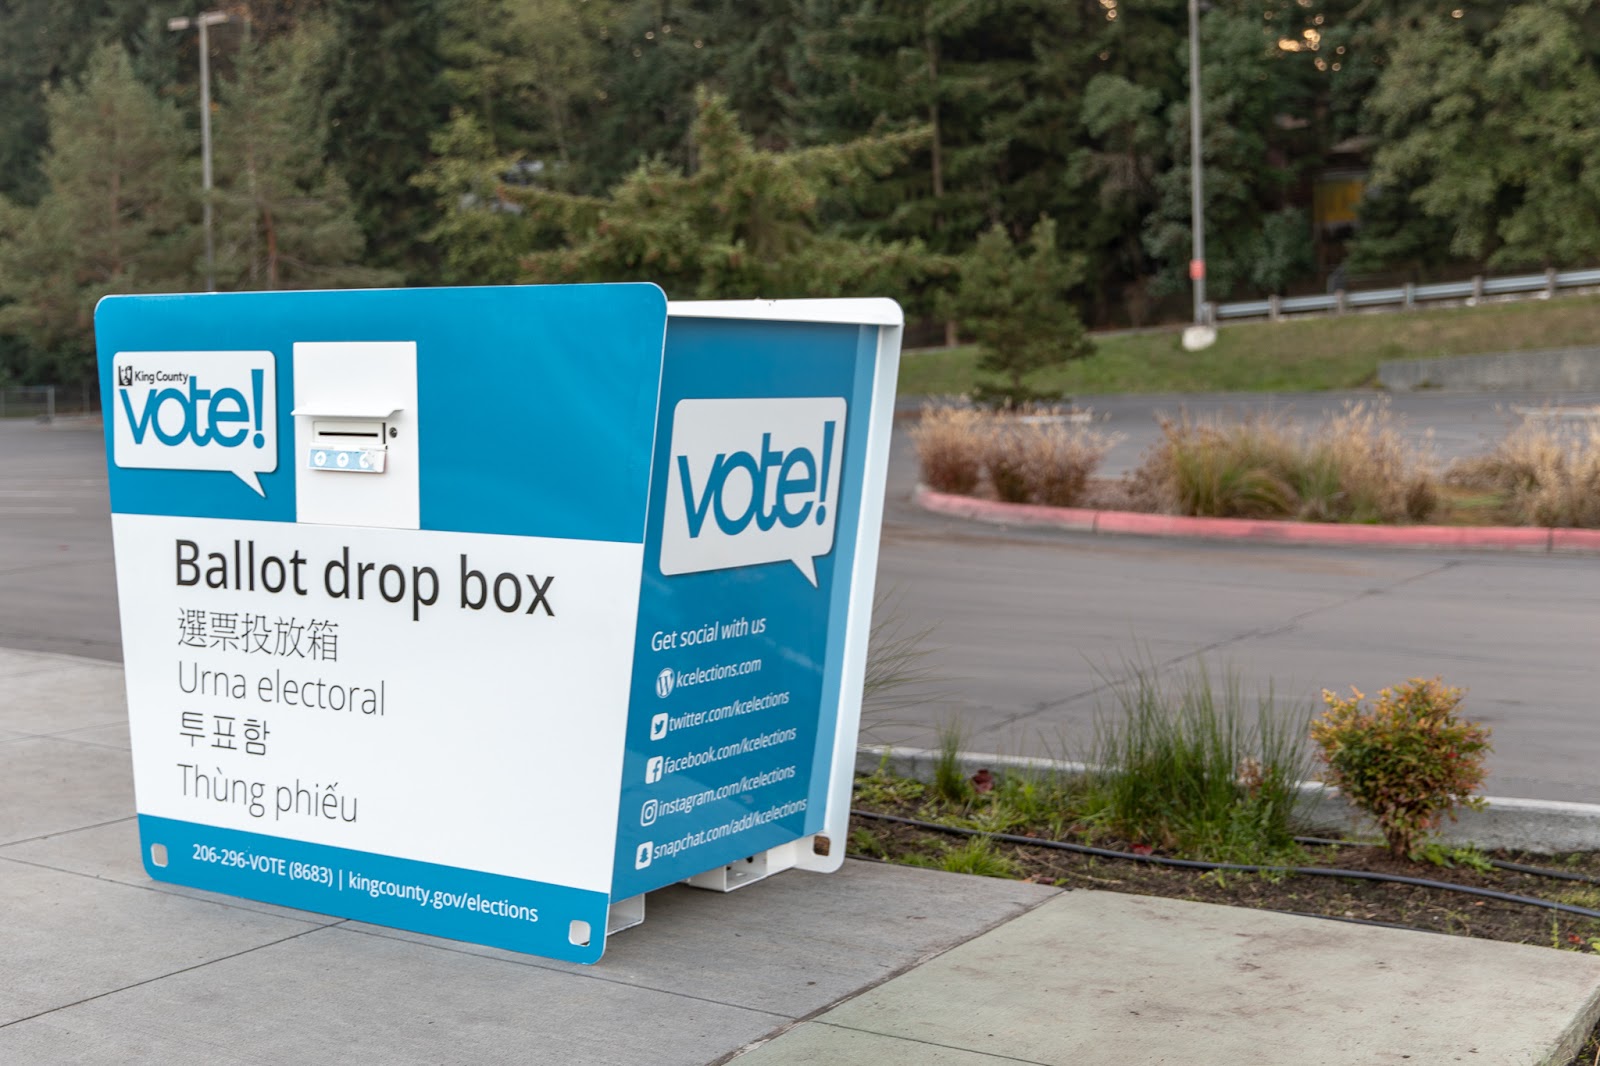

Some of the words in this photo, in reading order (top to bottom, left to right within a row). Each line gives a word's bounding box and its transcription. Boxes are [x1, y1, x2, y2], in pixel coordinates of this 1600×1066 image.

[134, 370, 155, 384] King
[156, 370, 189, 385] County
[119, 368, 265, 449] vote!
[677, 420, 836, 539] vote!
[175, 538, 308, 597] Ballot
[324, 546, 440, 622] drop
[459, 553, 556, 617] box
[177, 606, 340, 663] 選票投放箱
[651, 630, 677, 652] Get
[680, 621, 719, 647] social
[721, 617, 749, 640] with
[751, 616, 767, 636] us
[178, 660, 247, 700] Urna
[257, 668, 386, 717] electoral
[675, 658, 762, 689] kcelections.com
[179, 711, 271, 756] 투표함
[668, 690, 790, 732] twitter.com/kcelections
[663, 726, 797, 775] facebook.com/kcelections
[177, 763, 266, 818] Thùng
[276, 778, 358, 823] phiếu
[658, 763, 796, 817] instagram.com/kcelections
[653, 798, 808, 860] snapchat.com/add/kcelections
[192, 843, 286, 876] 206-296-VOTE
[288, 863, 333, 888] (8683)
[348, 871, 540, 923] kingcounty.gov/elections
